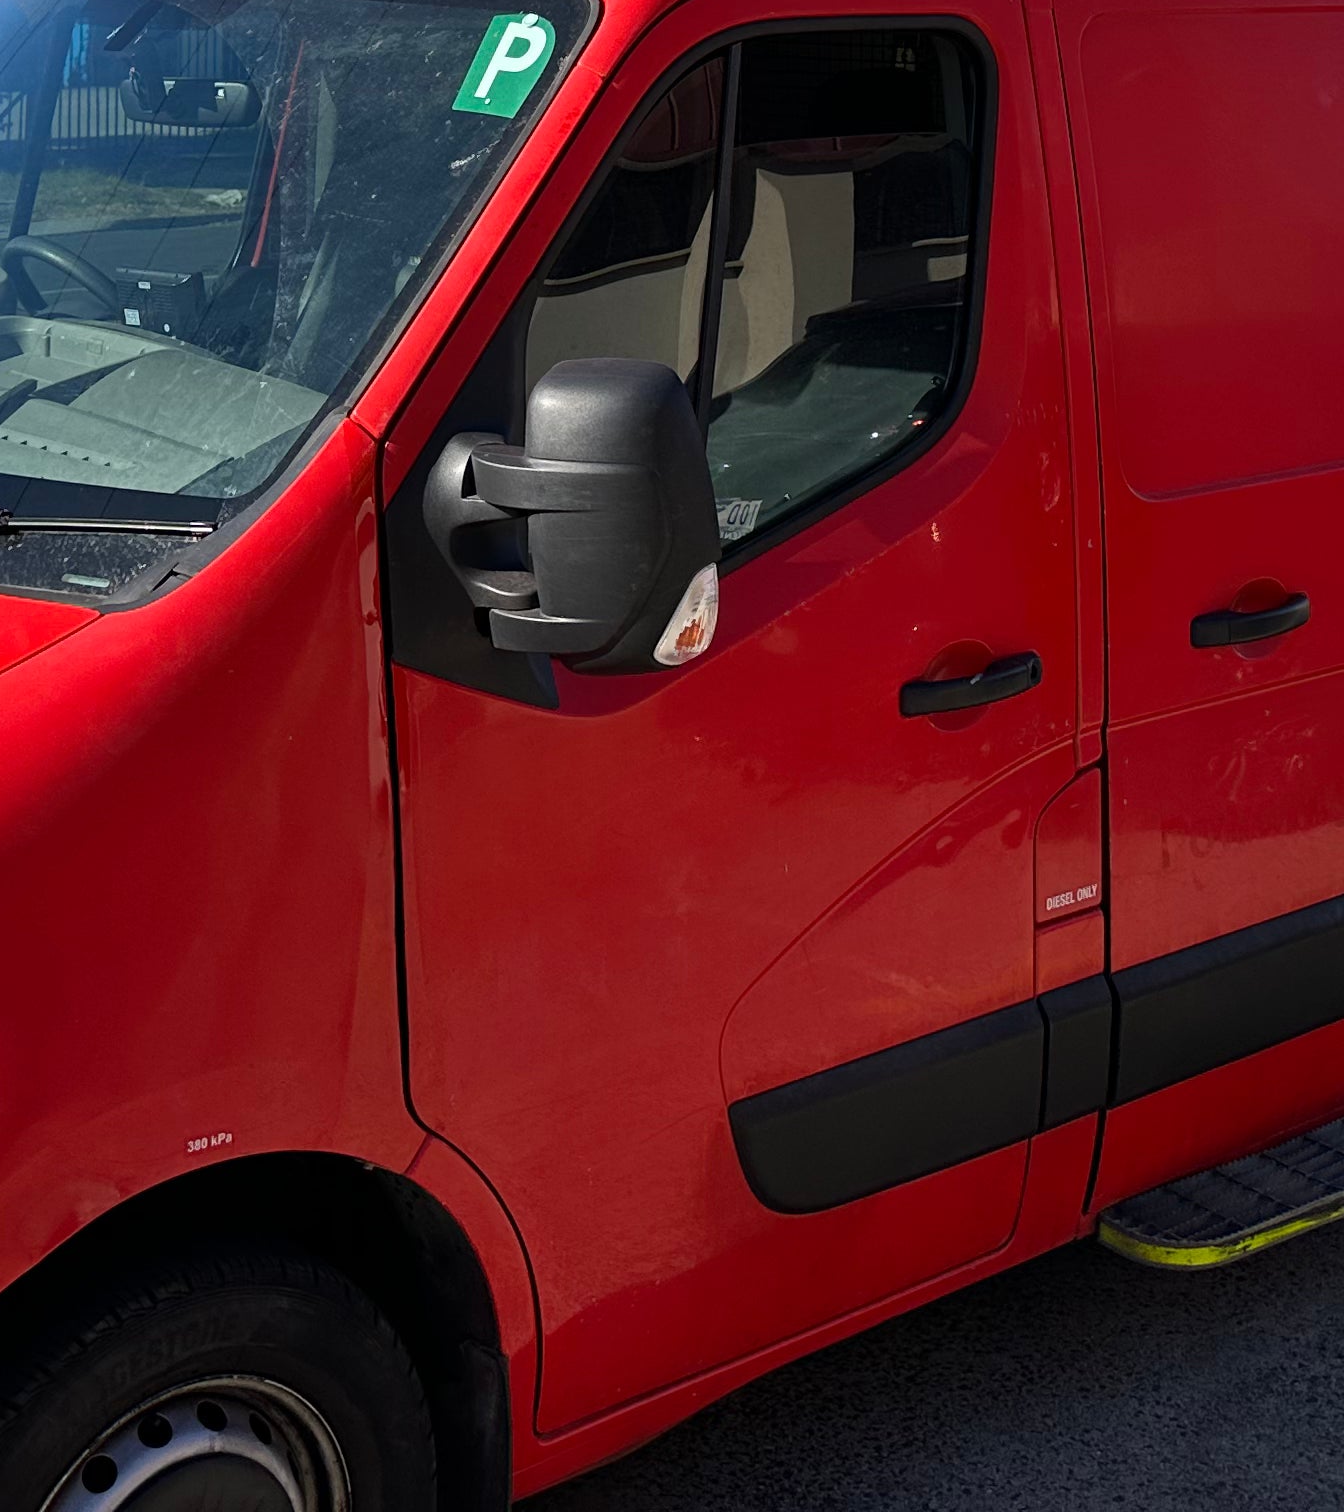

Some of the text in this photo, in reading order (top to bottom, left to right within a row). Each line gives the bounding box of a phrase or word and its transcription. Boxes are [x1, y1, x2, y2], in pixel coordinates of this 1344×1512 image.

[474, 21, 547, 99] P
[1046, 883, 1098, 911] DIESEL ONLY
[187, 1133, 233, 1153] 380 kPa
